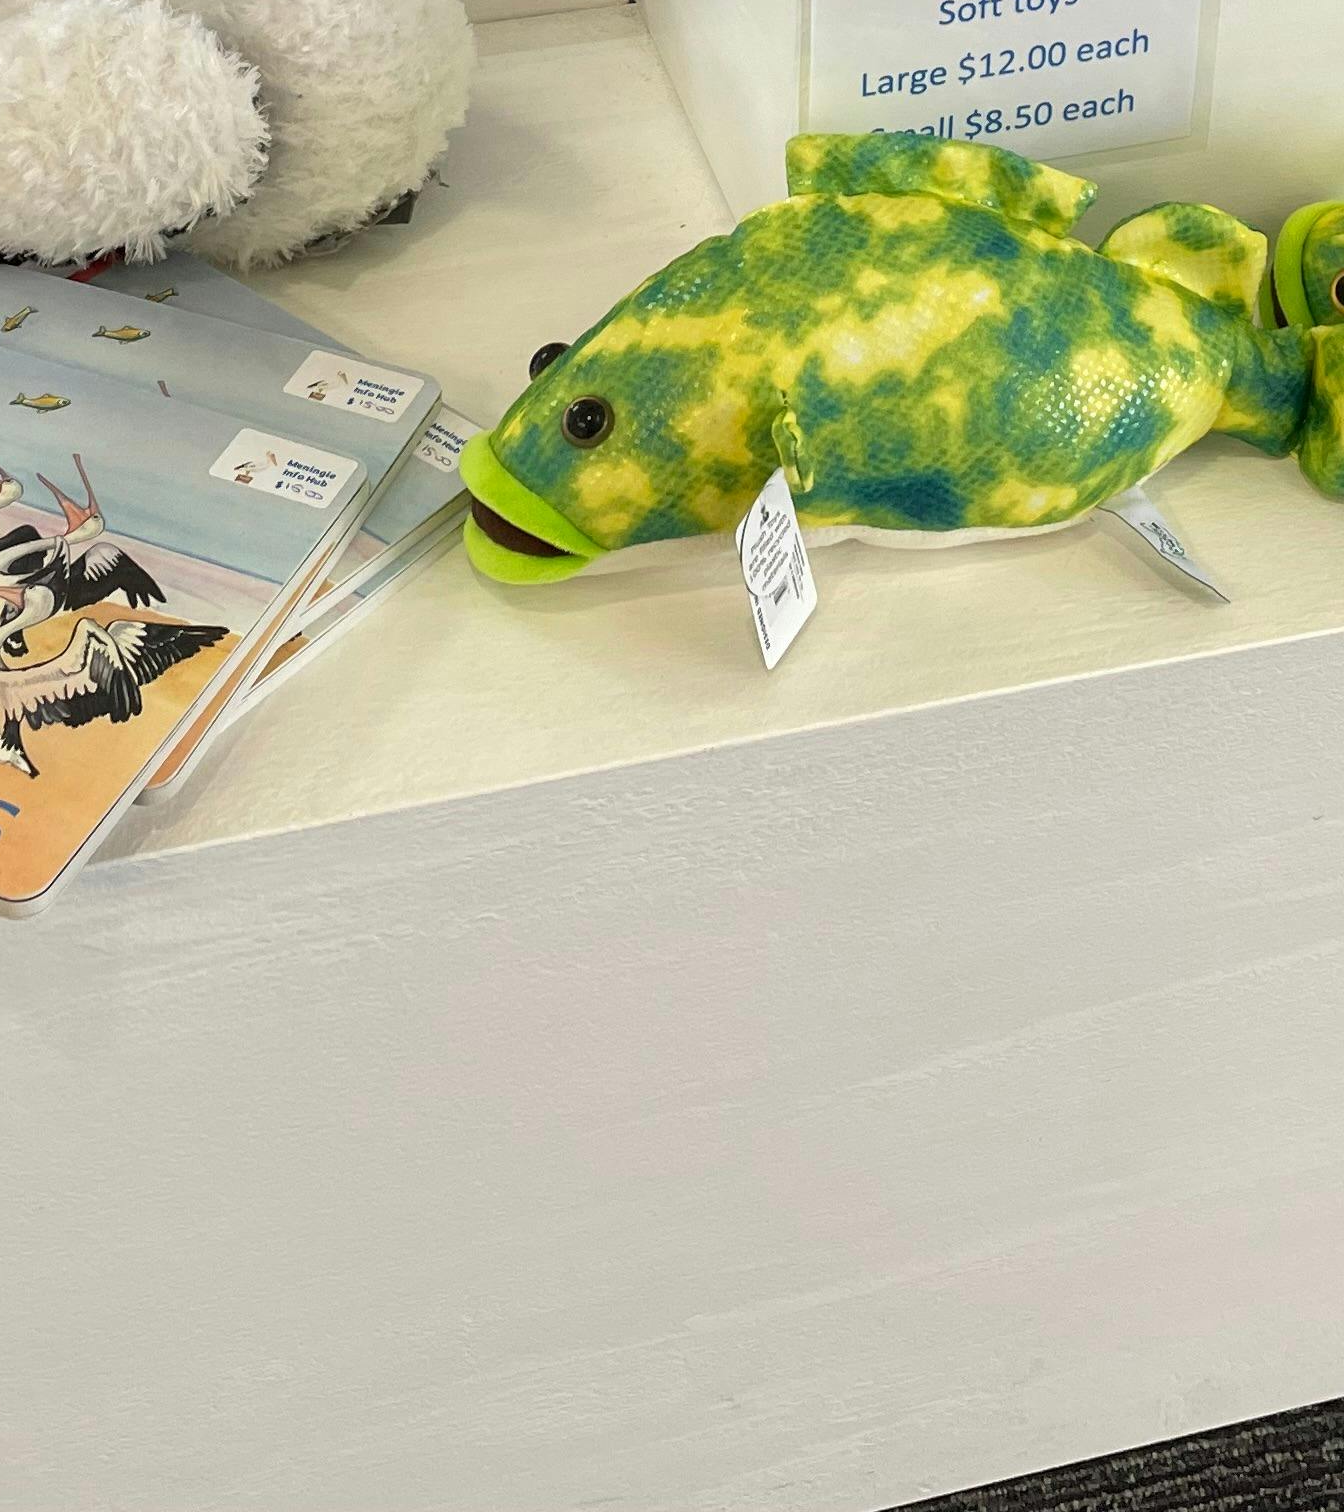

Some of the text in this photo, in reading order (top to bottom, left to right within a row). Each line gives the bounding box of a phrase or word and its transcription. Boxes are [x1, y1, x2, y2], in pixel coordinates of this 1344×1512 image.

[861, 28, 1149, 97] Large $12.00 each
[870, 88, 1135, 139] all $8.50 each
[353, 387, 398, 404] Info Hub
[357, 378, 405, 397] Meningie
[424, 430, 460, 454] Info Hub
[430, 422, 468, 446] Meningi
[282, 469, 328, 488] Info Hub
[286, 459, 337, 480] Meningie
